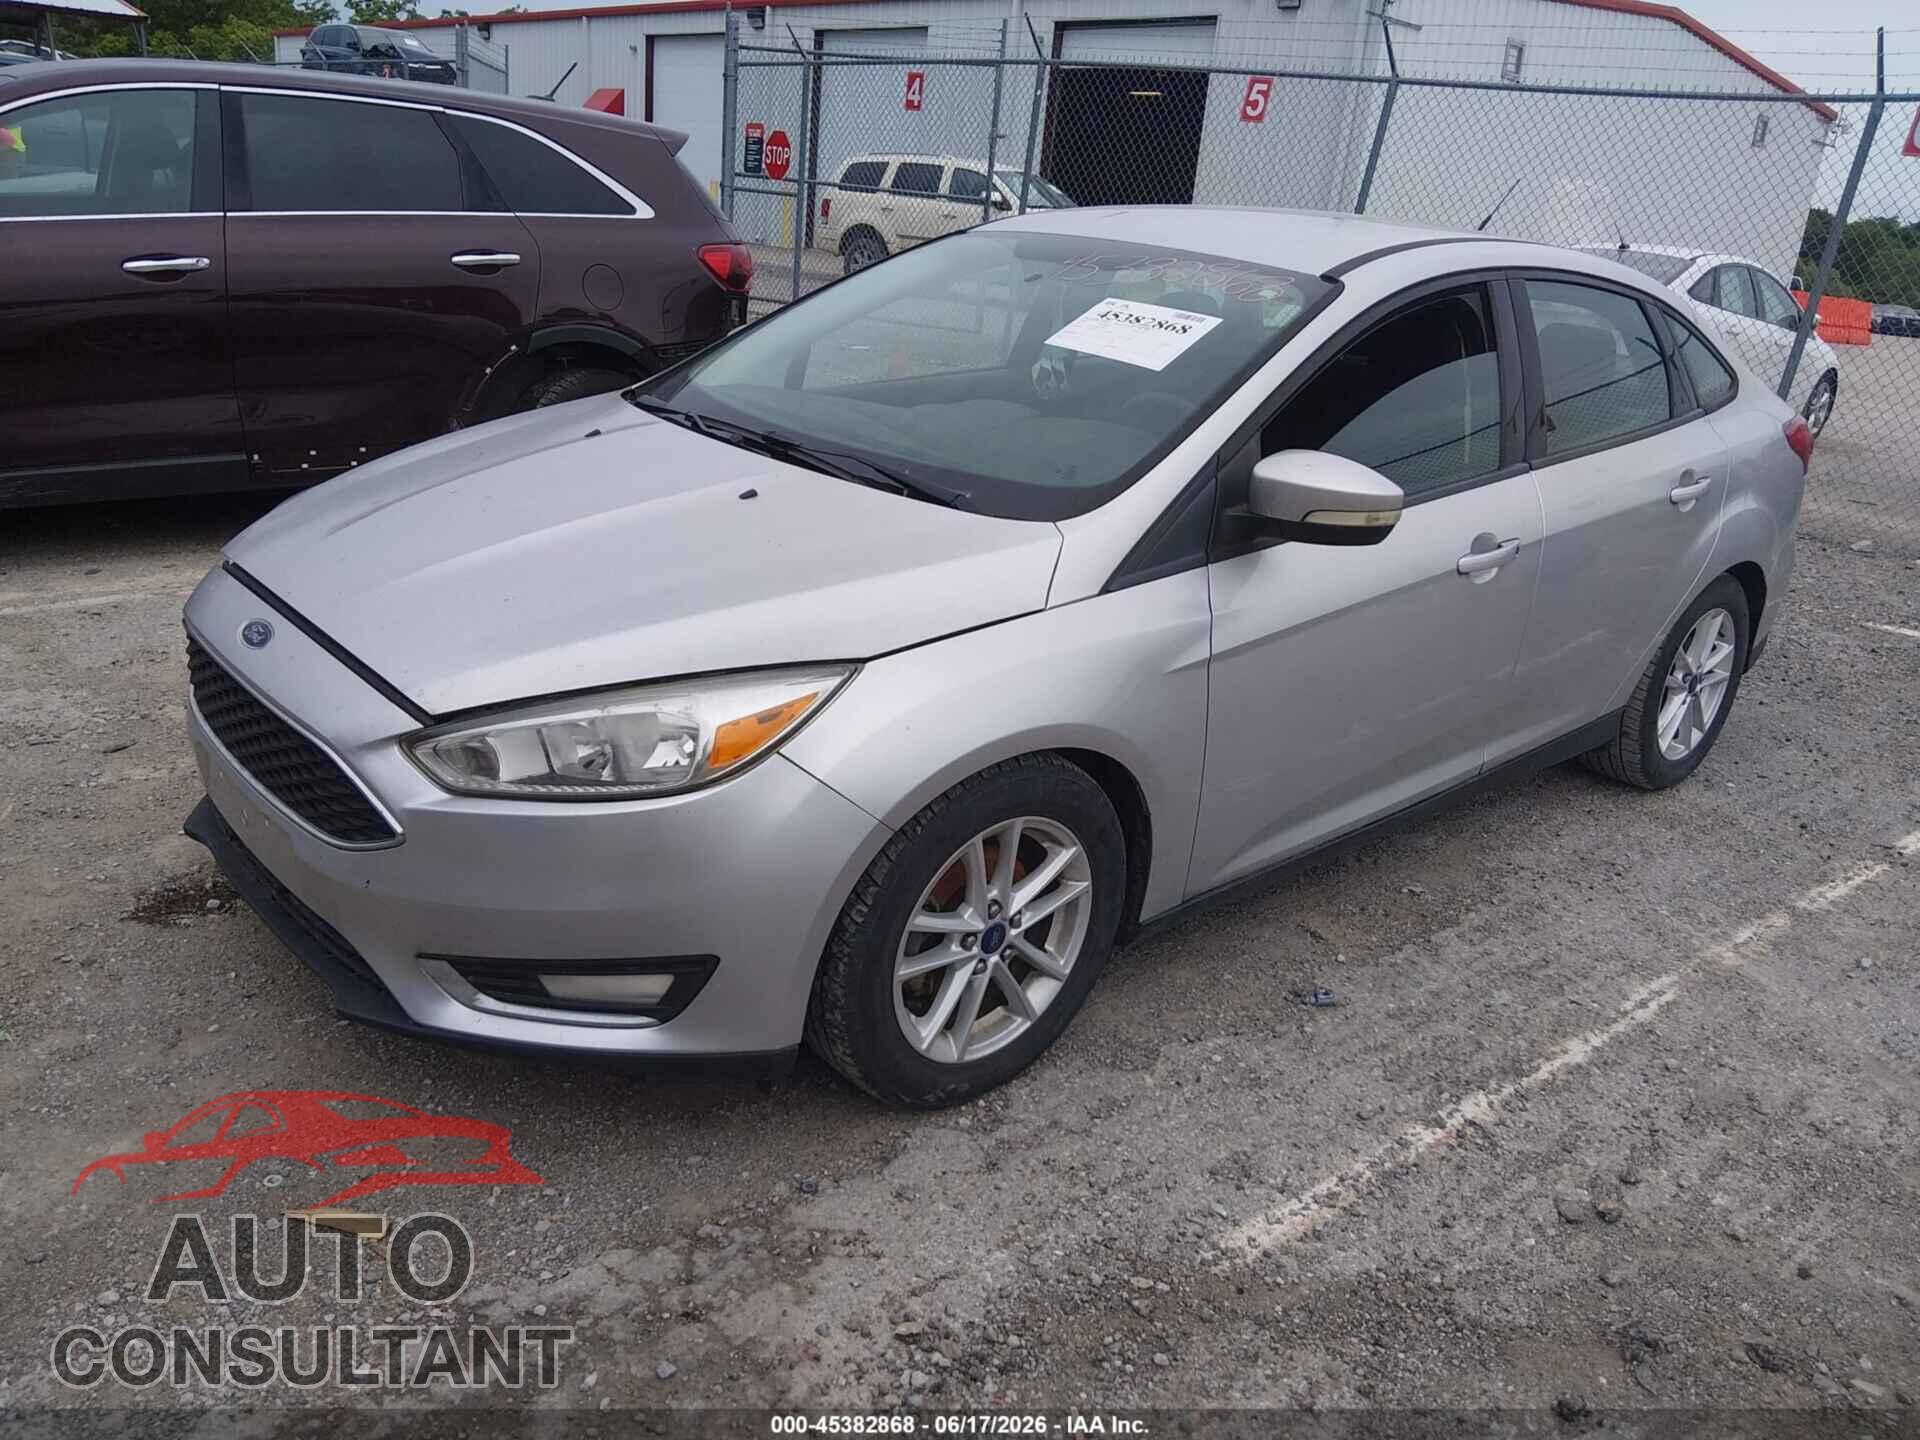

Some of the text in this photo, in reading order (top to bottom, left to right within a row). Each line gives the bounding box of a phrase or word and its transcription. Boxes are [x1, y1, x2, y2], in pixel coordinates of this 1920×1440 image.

[907, 77, 921, 106] 4
[1246, 83, 1269, 117] 5
[766, 145, 790, 166] STOP
[1097, 309, 1193, 335] 45382868
